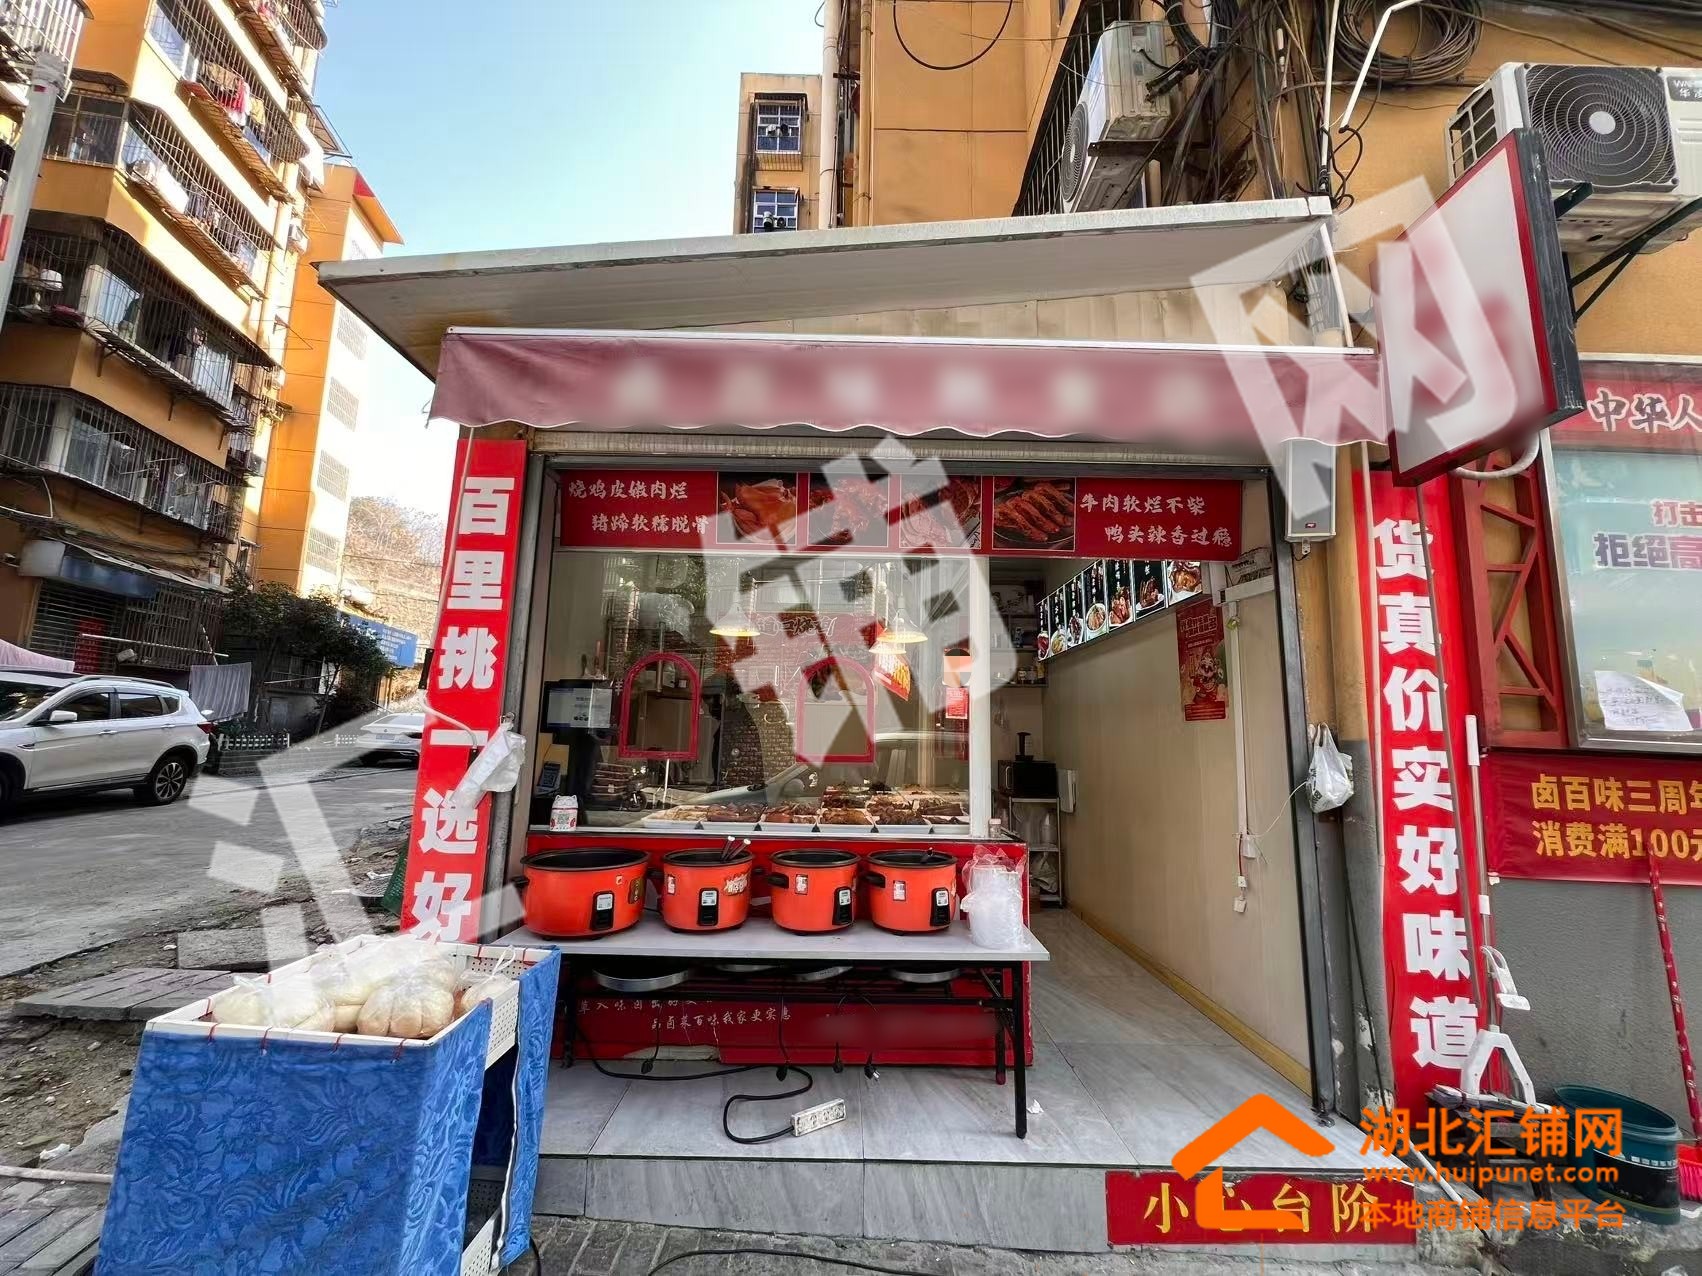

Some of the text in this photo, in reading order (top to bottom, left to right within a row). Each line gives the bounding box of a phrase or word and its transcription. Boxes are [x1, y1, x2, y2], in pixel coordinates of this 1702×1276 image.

[1587, 387, 1702, 434] 中华人
[569, 479, 689, 499] 烧鸡皮嫩肉烂
[1080, 492, 1206, 516] 牛肉软烂不柴
[1651, 499, 1702, 527] 打击
[591, 513, 709, 535] 猪蹄软糯脱骨
[1104, 524, 1233, 548] 鸭头辣香过瘾
[410, 476, 515, 943] 百里挑一选好
[1373, 517, 1479, 1070] 货真价实好味道
